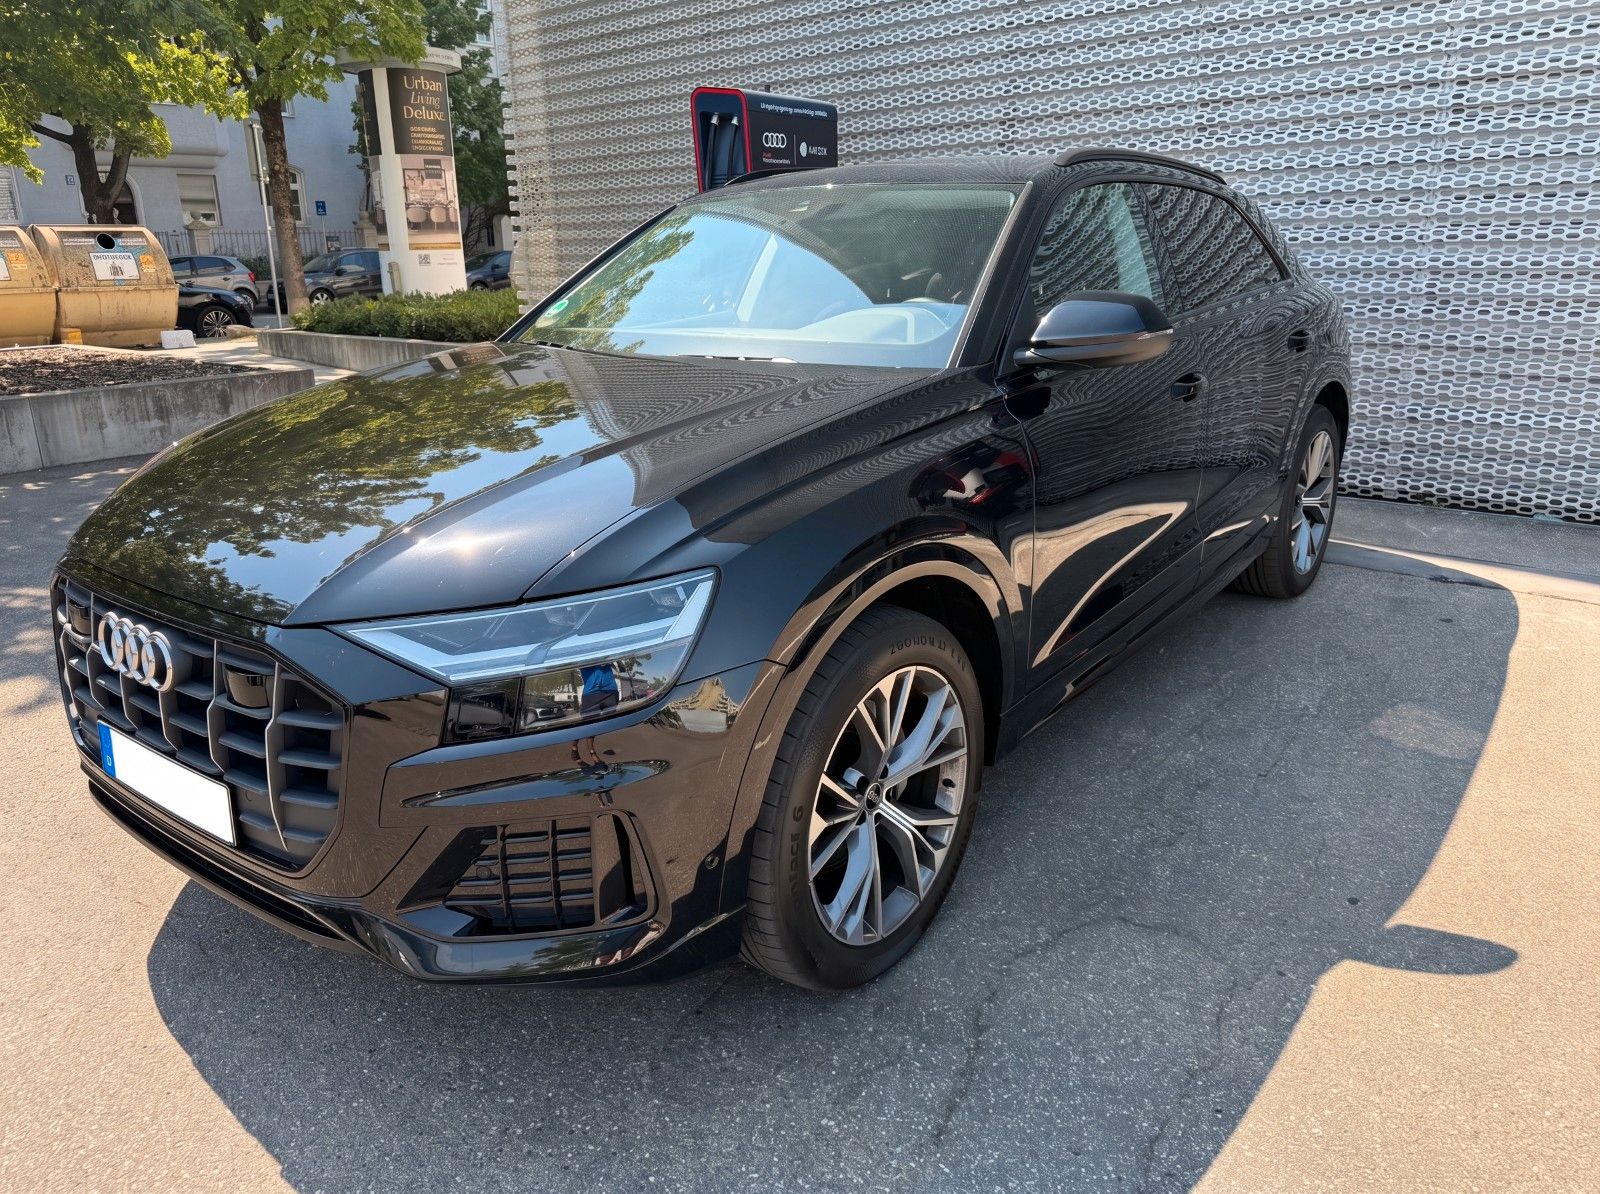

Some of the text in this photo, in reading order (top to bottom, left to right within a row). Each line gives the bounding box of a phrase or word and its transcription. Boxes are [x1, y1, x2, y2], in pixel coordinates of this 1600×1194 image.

[404, 76, 442, 91] Urban
[411, 92, 440, 109] Living
[403, 106, 446, 121] Deluxe
